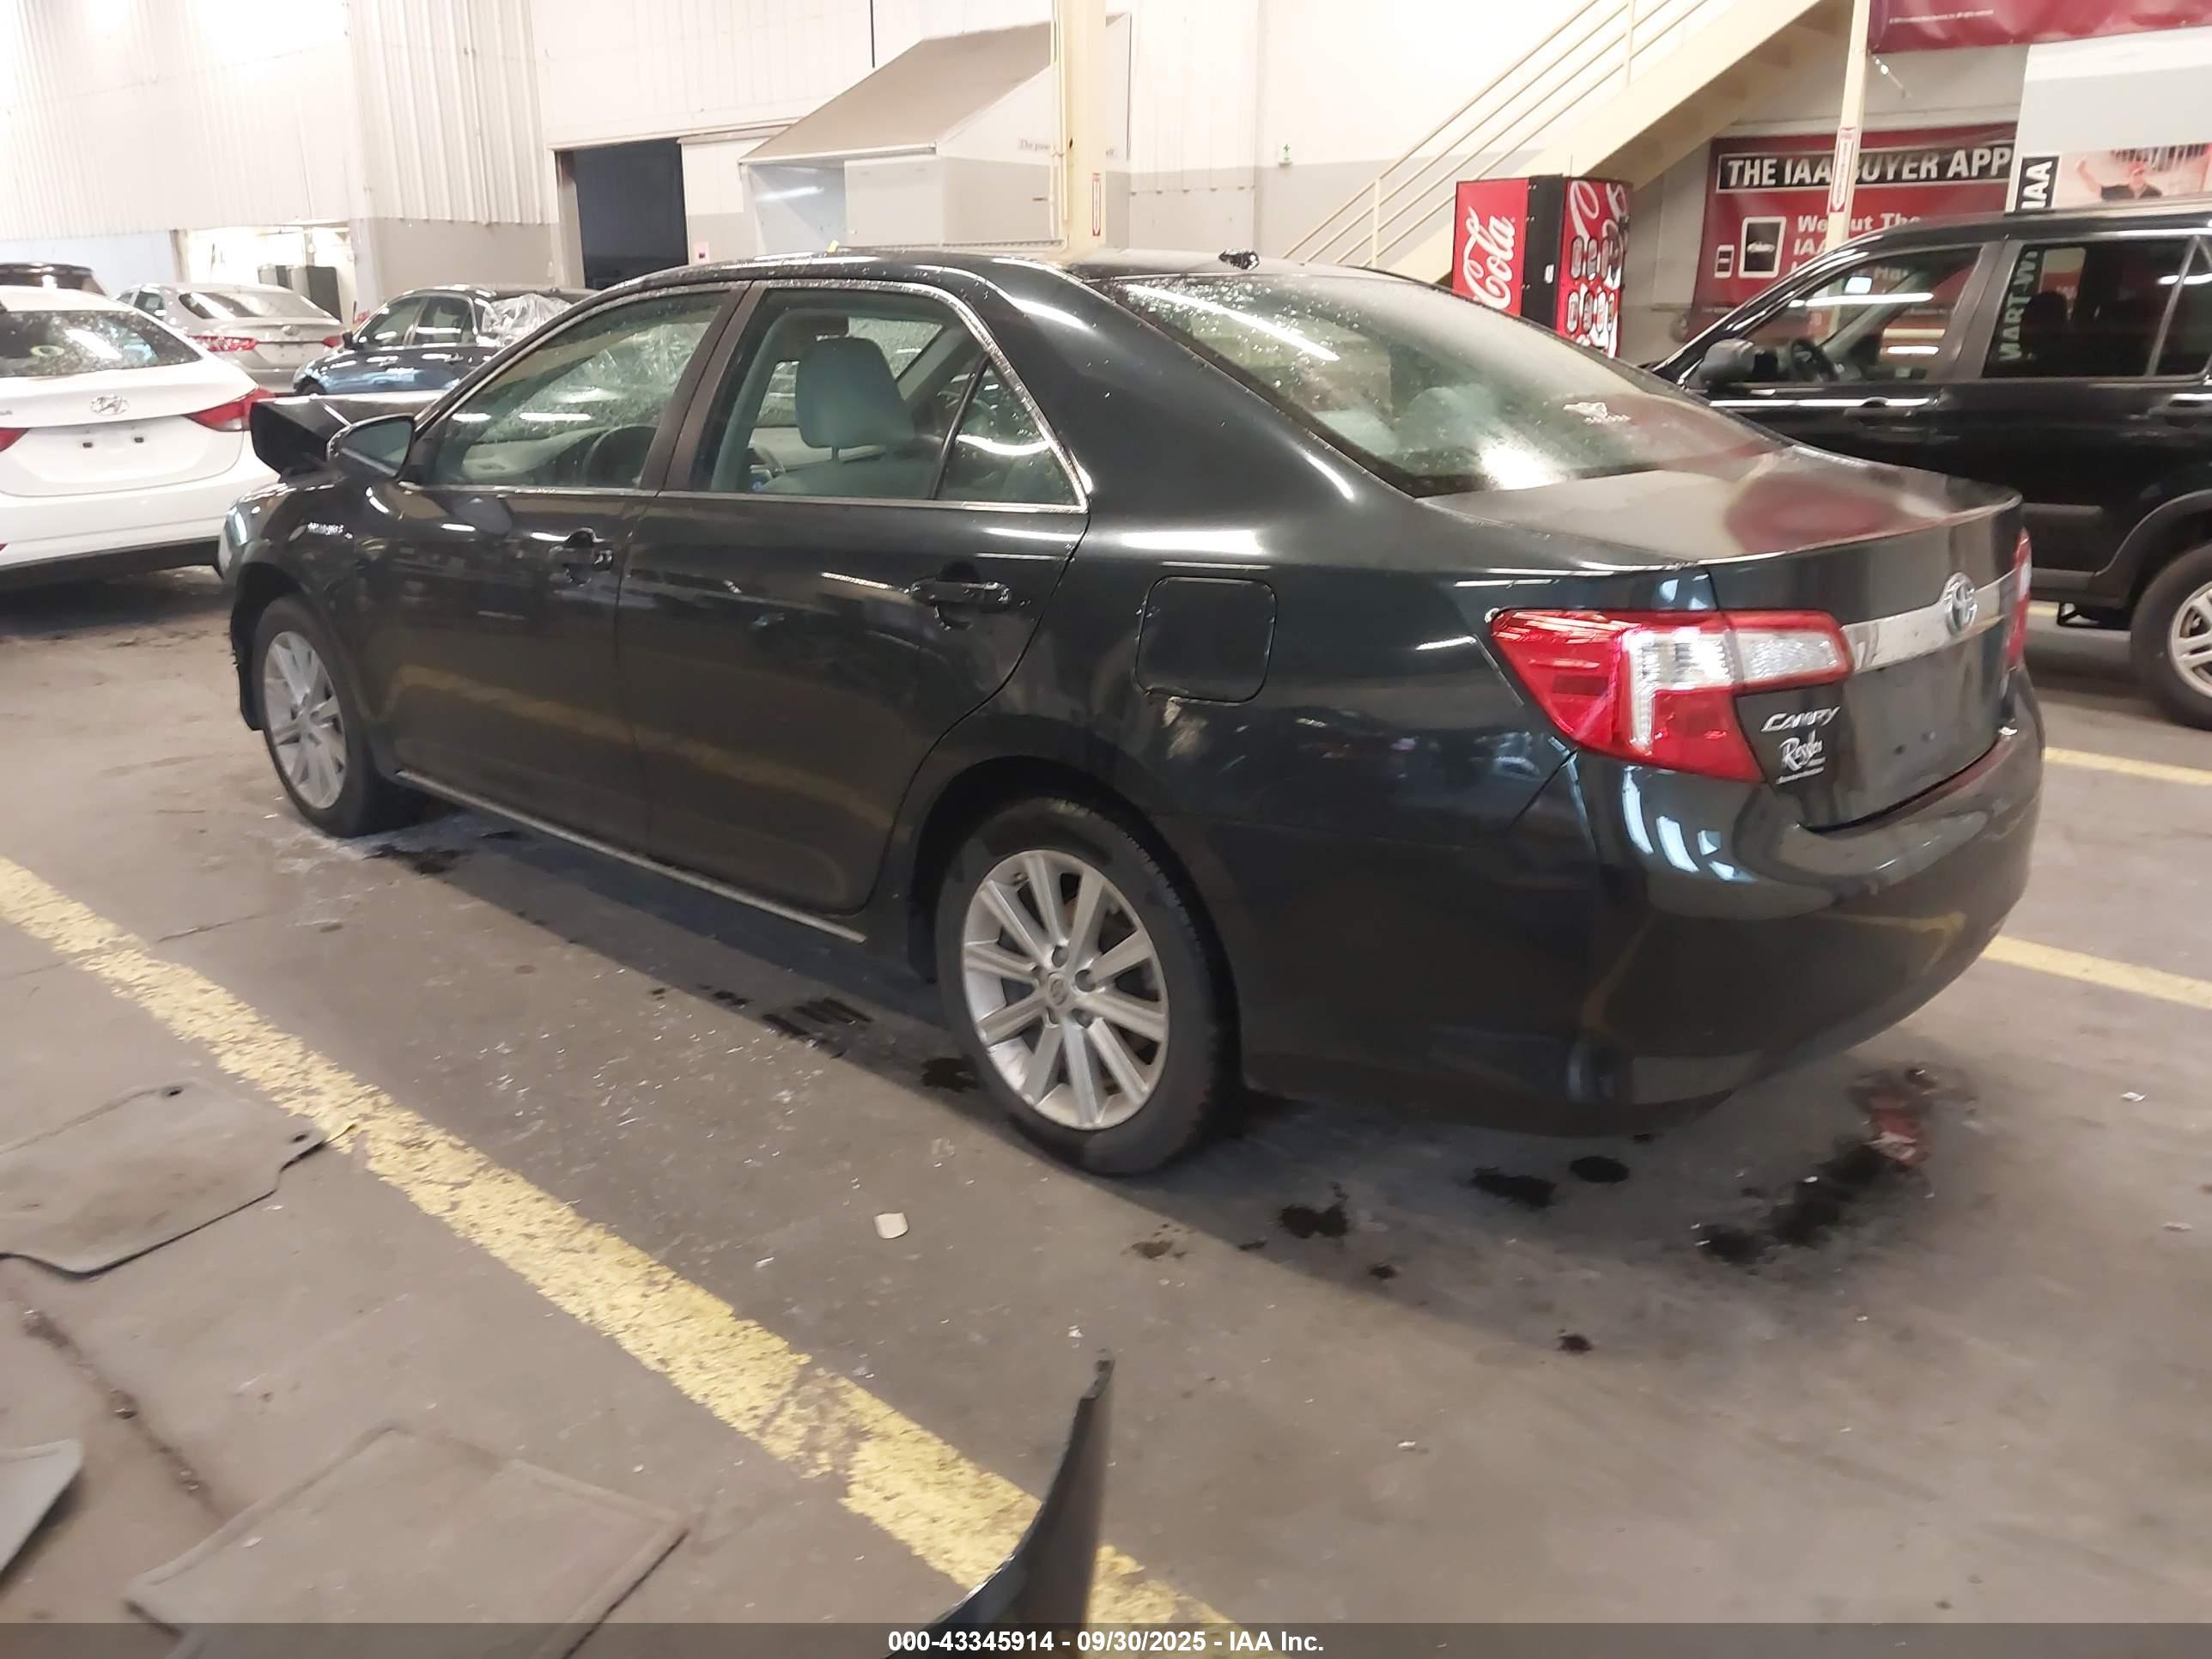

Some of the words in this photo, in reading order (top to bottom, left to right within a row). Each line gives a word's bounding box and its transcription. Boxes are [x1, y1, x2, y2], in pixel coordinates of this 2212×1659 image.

[1728, 158, 1778, 186] THE
[1784, 157, 1832, 185] IAA
[1855, 151, 1940, 182] UYER
[1947, 147, 2012, 178] APP
[2021, 161, 2053, 210] IAA
[1463, 205, 1515, 310] Cola
